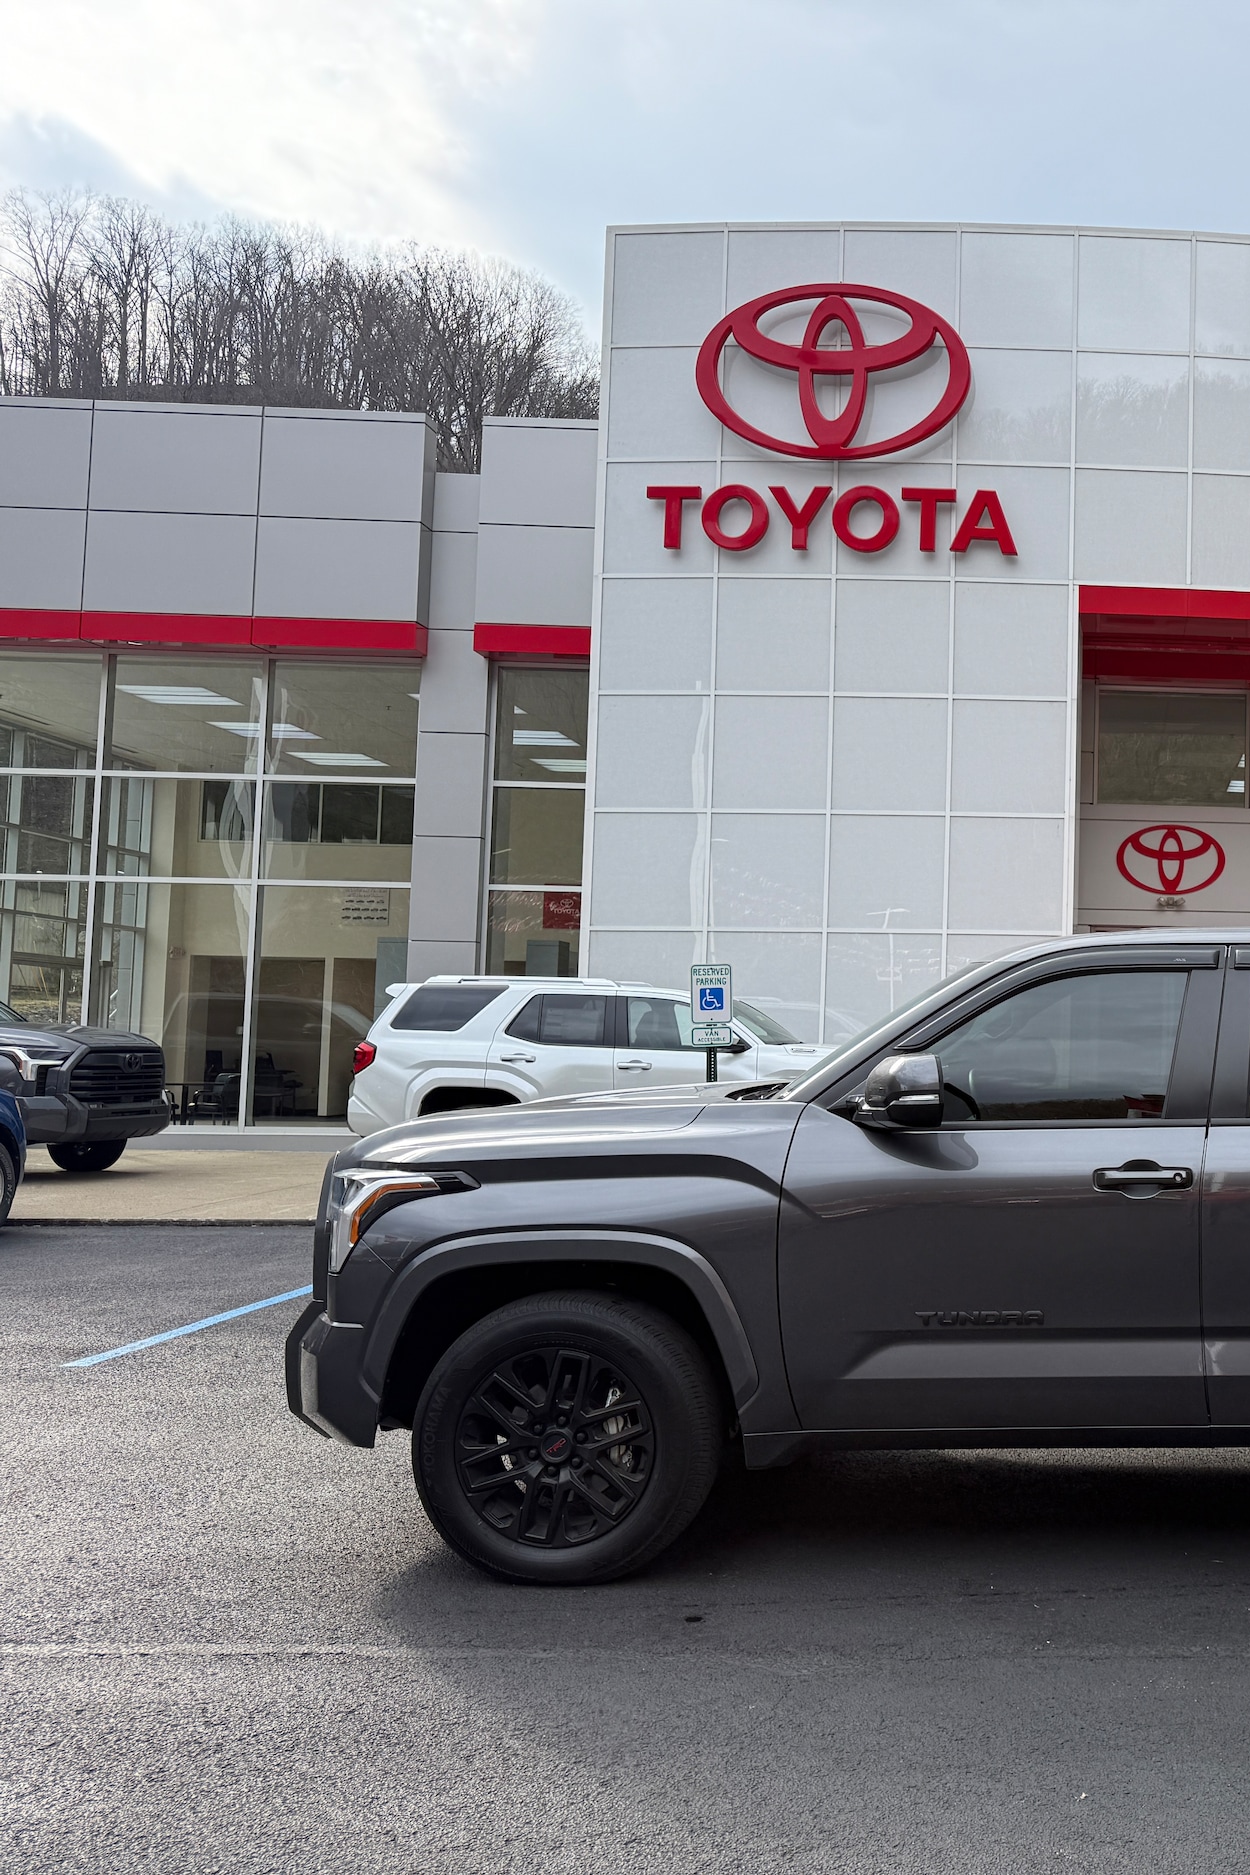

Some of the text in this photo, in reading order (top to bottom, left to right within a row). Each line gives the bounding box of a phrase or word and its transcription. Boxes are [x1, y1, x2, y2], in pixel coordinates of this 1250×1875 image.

[646, 484, 1019, 557] TOYOTA
[553, 908, 580, 917] TOYOTA
[692, 967, 730, 977] RESERVED
[695, 977, 727, 986] PARKING
[914, 1309, 1046, 1327] TUNDRA
[423, 1386, 452, 1474] YOKOHAMA
